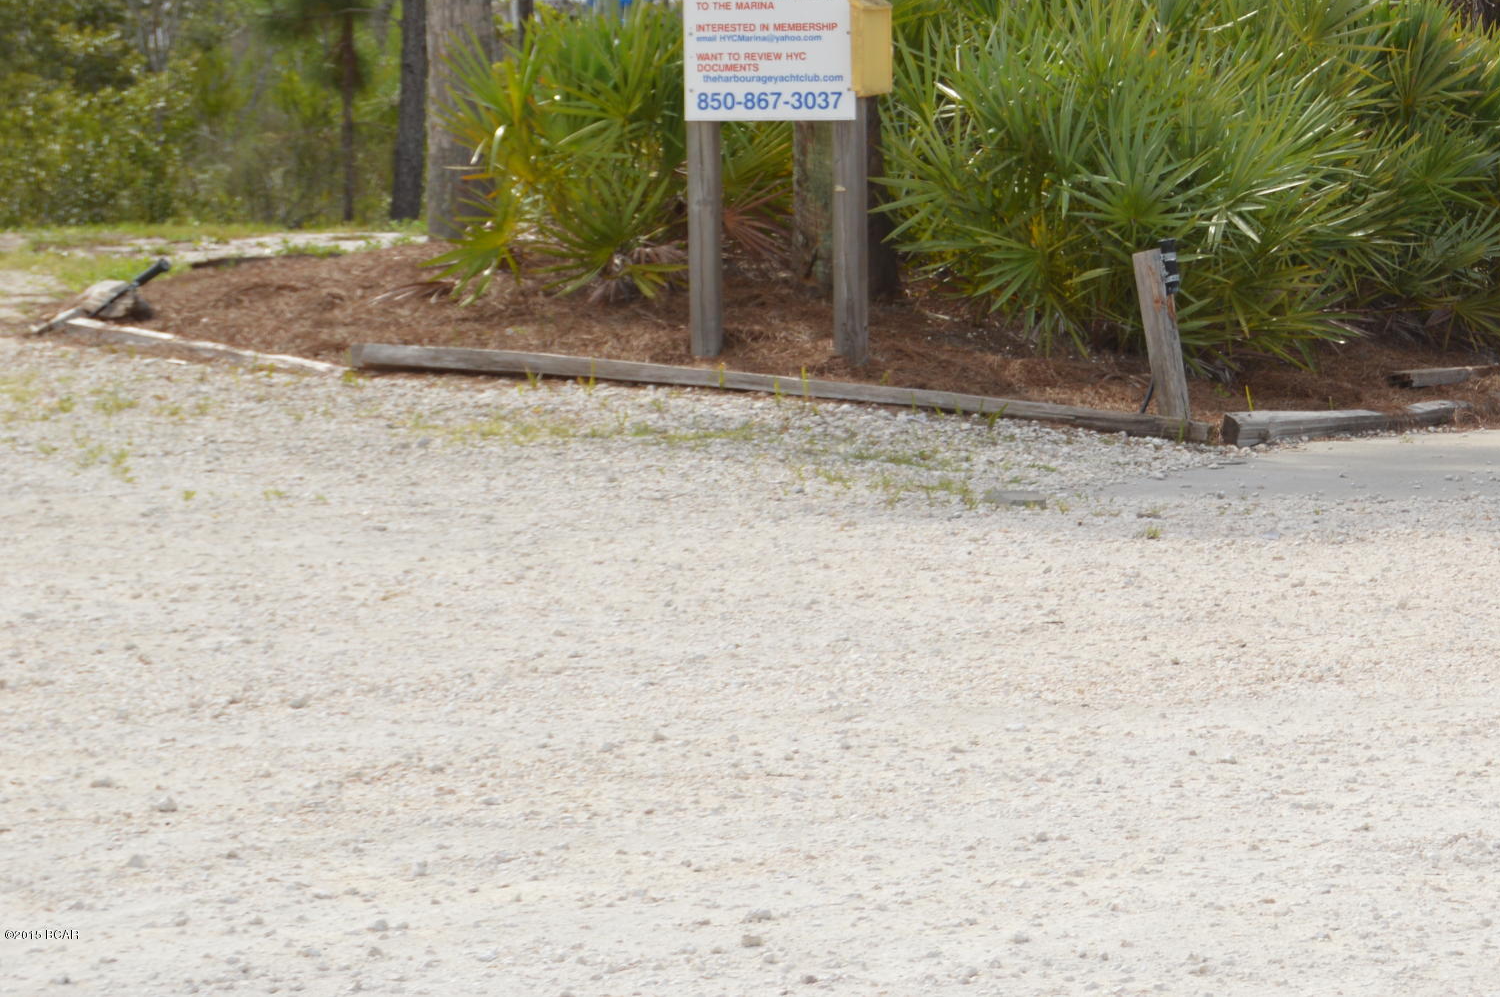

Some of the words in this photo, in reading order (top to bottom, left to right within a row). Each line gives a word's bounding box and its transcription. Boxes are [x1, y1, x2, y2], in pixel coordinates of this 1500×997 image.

[696, 1, 709, 11] TO
[713, 1, 732, 10] THE
[735, 1, 774, 10] MARINA
[696, 23, 756, 32] INTERESTED
[760, 23, 769, 32] IN
[773, 22, 838, 32] MEMBERSHIP
[696, 52, 723, 61] WANT
[727, 52, 740, 61] TO
[744, 52, 782, 61] REVIEW
[786, 52, 806, 61] HYC
[697, 63, 759, 72] DOCUMENTS
[703, 73, 843, 84] theharbourageyachtclub.com
[697, 91, 842, 110] 850-867-3037
